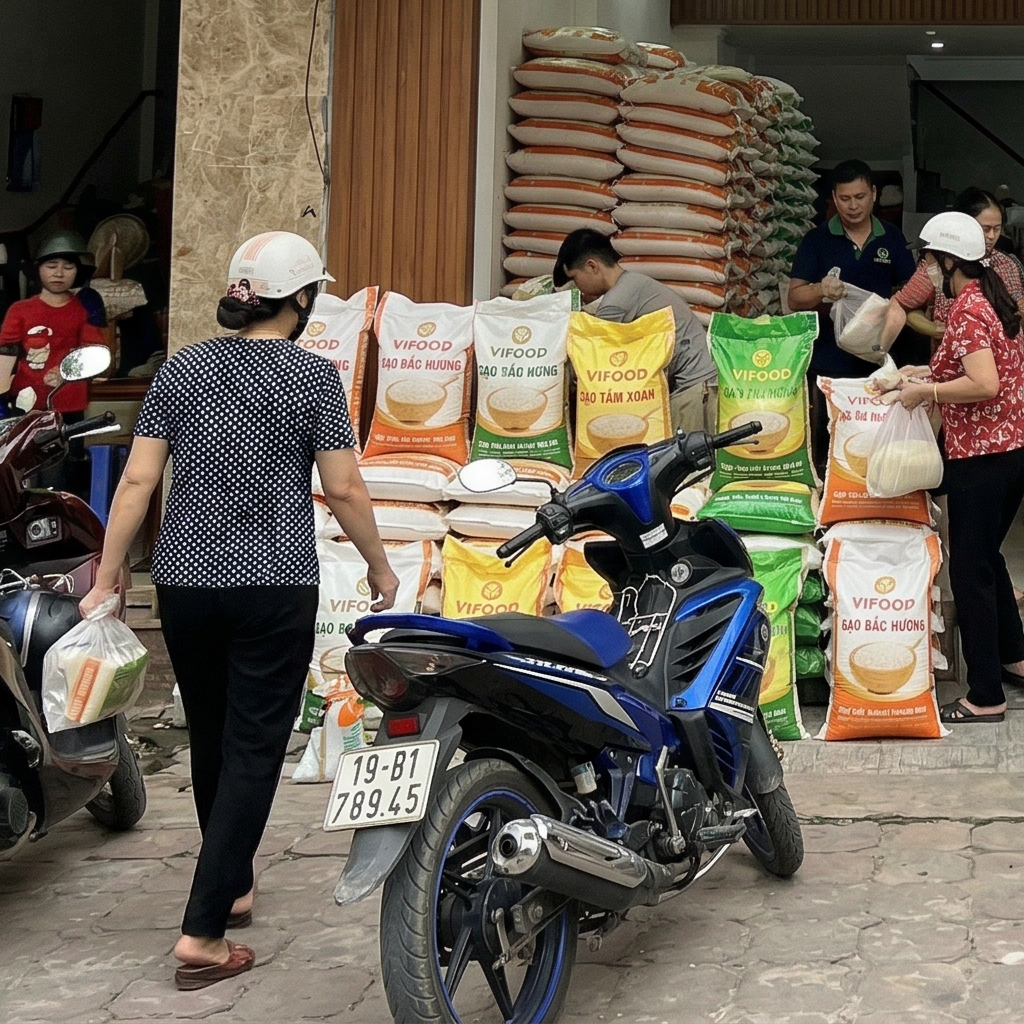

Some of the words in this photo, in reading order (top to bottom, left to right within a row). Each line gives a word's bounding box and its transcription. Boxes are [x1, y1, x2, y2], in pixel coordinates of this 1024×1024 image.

[393, 339, 453, 352] VIFOOD
[490, 346, 548, 359] VIFOOD
[586, 368, 649, 382] VIFOOD
[732, 368, 792, 382] VIFOOD
[852, 597, 916, 612] VIFOOD
[353, 748, 420, 786] 19-B1
[332, 783, 421, 824] 789.45
